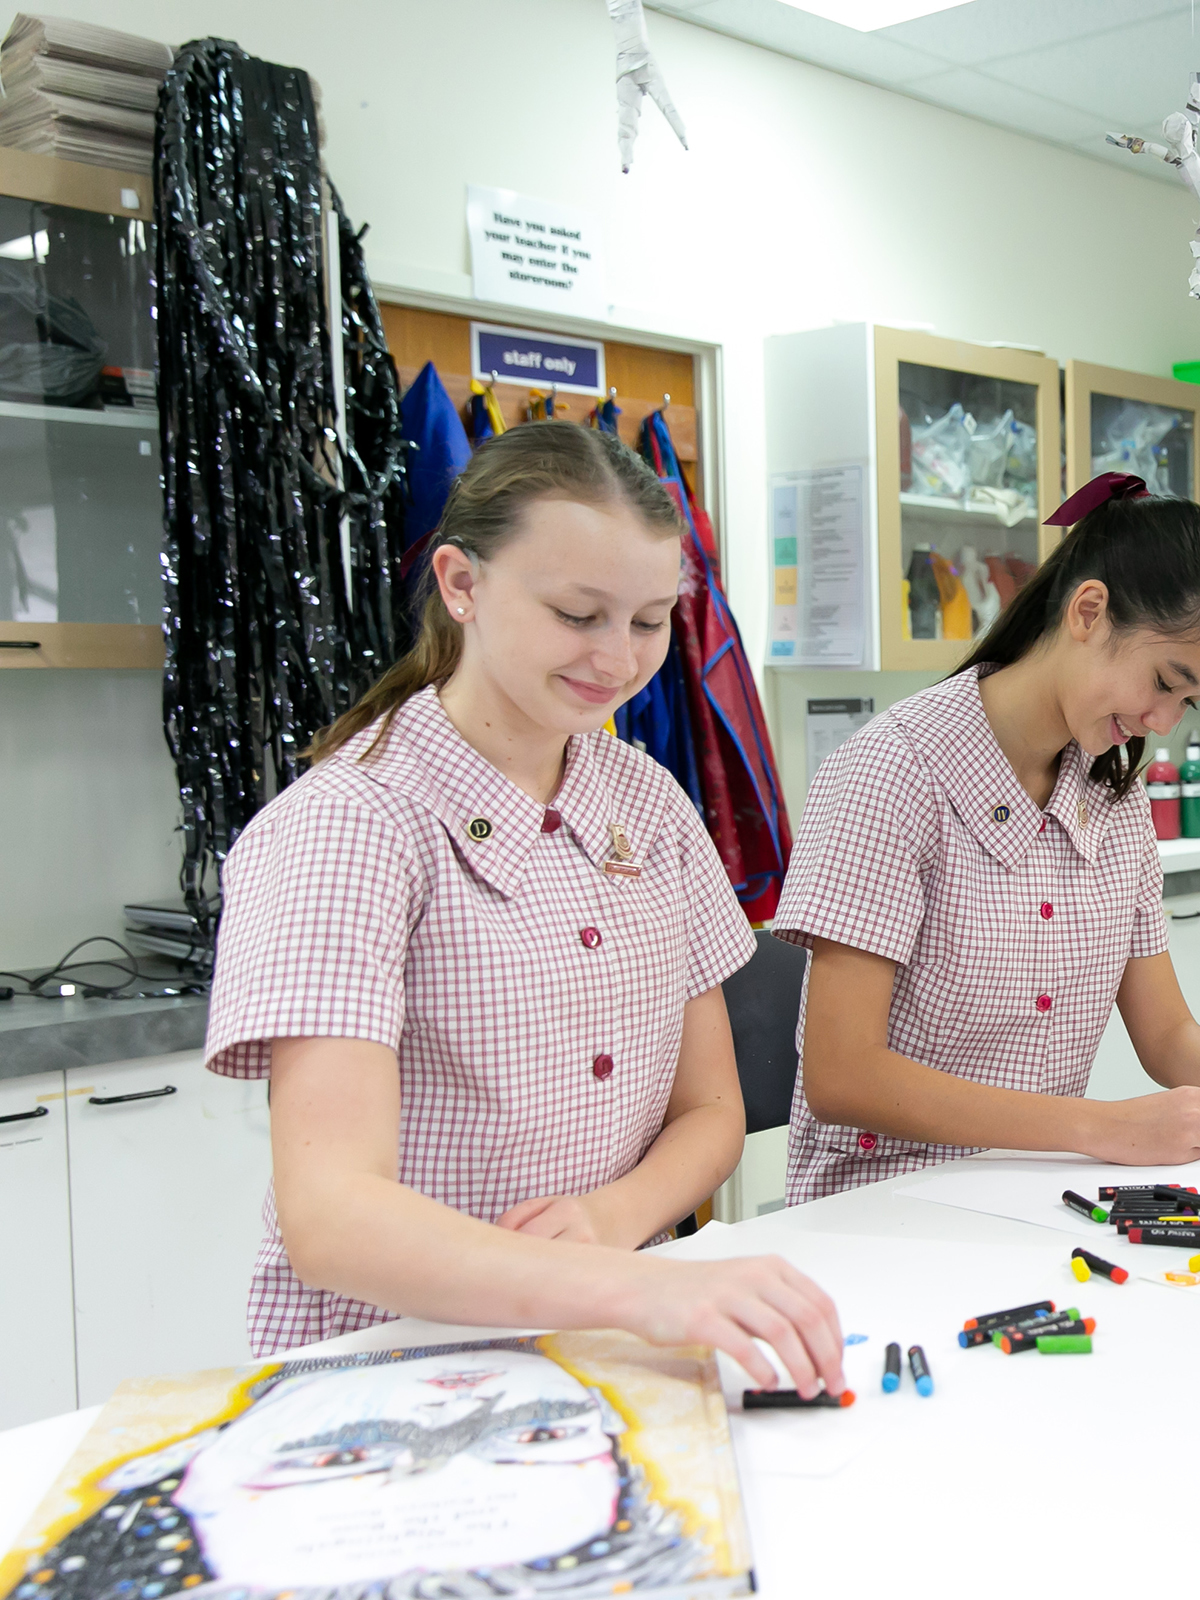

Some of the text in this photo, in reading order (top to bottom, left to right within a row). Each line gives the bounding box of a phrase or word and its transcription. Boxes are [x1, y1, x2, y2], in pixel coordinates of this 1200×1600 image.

[493, 212, 581, 240] Have you asked
[485, 230, 591, 260] your teacher if you
[501, 252, 578, 273] may enter the
[509, 270, 573, 290] storeroom?
[502, 350, 577, 377] staff only
[474, 821, 488, 837] D
